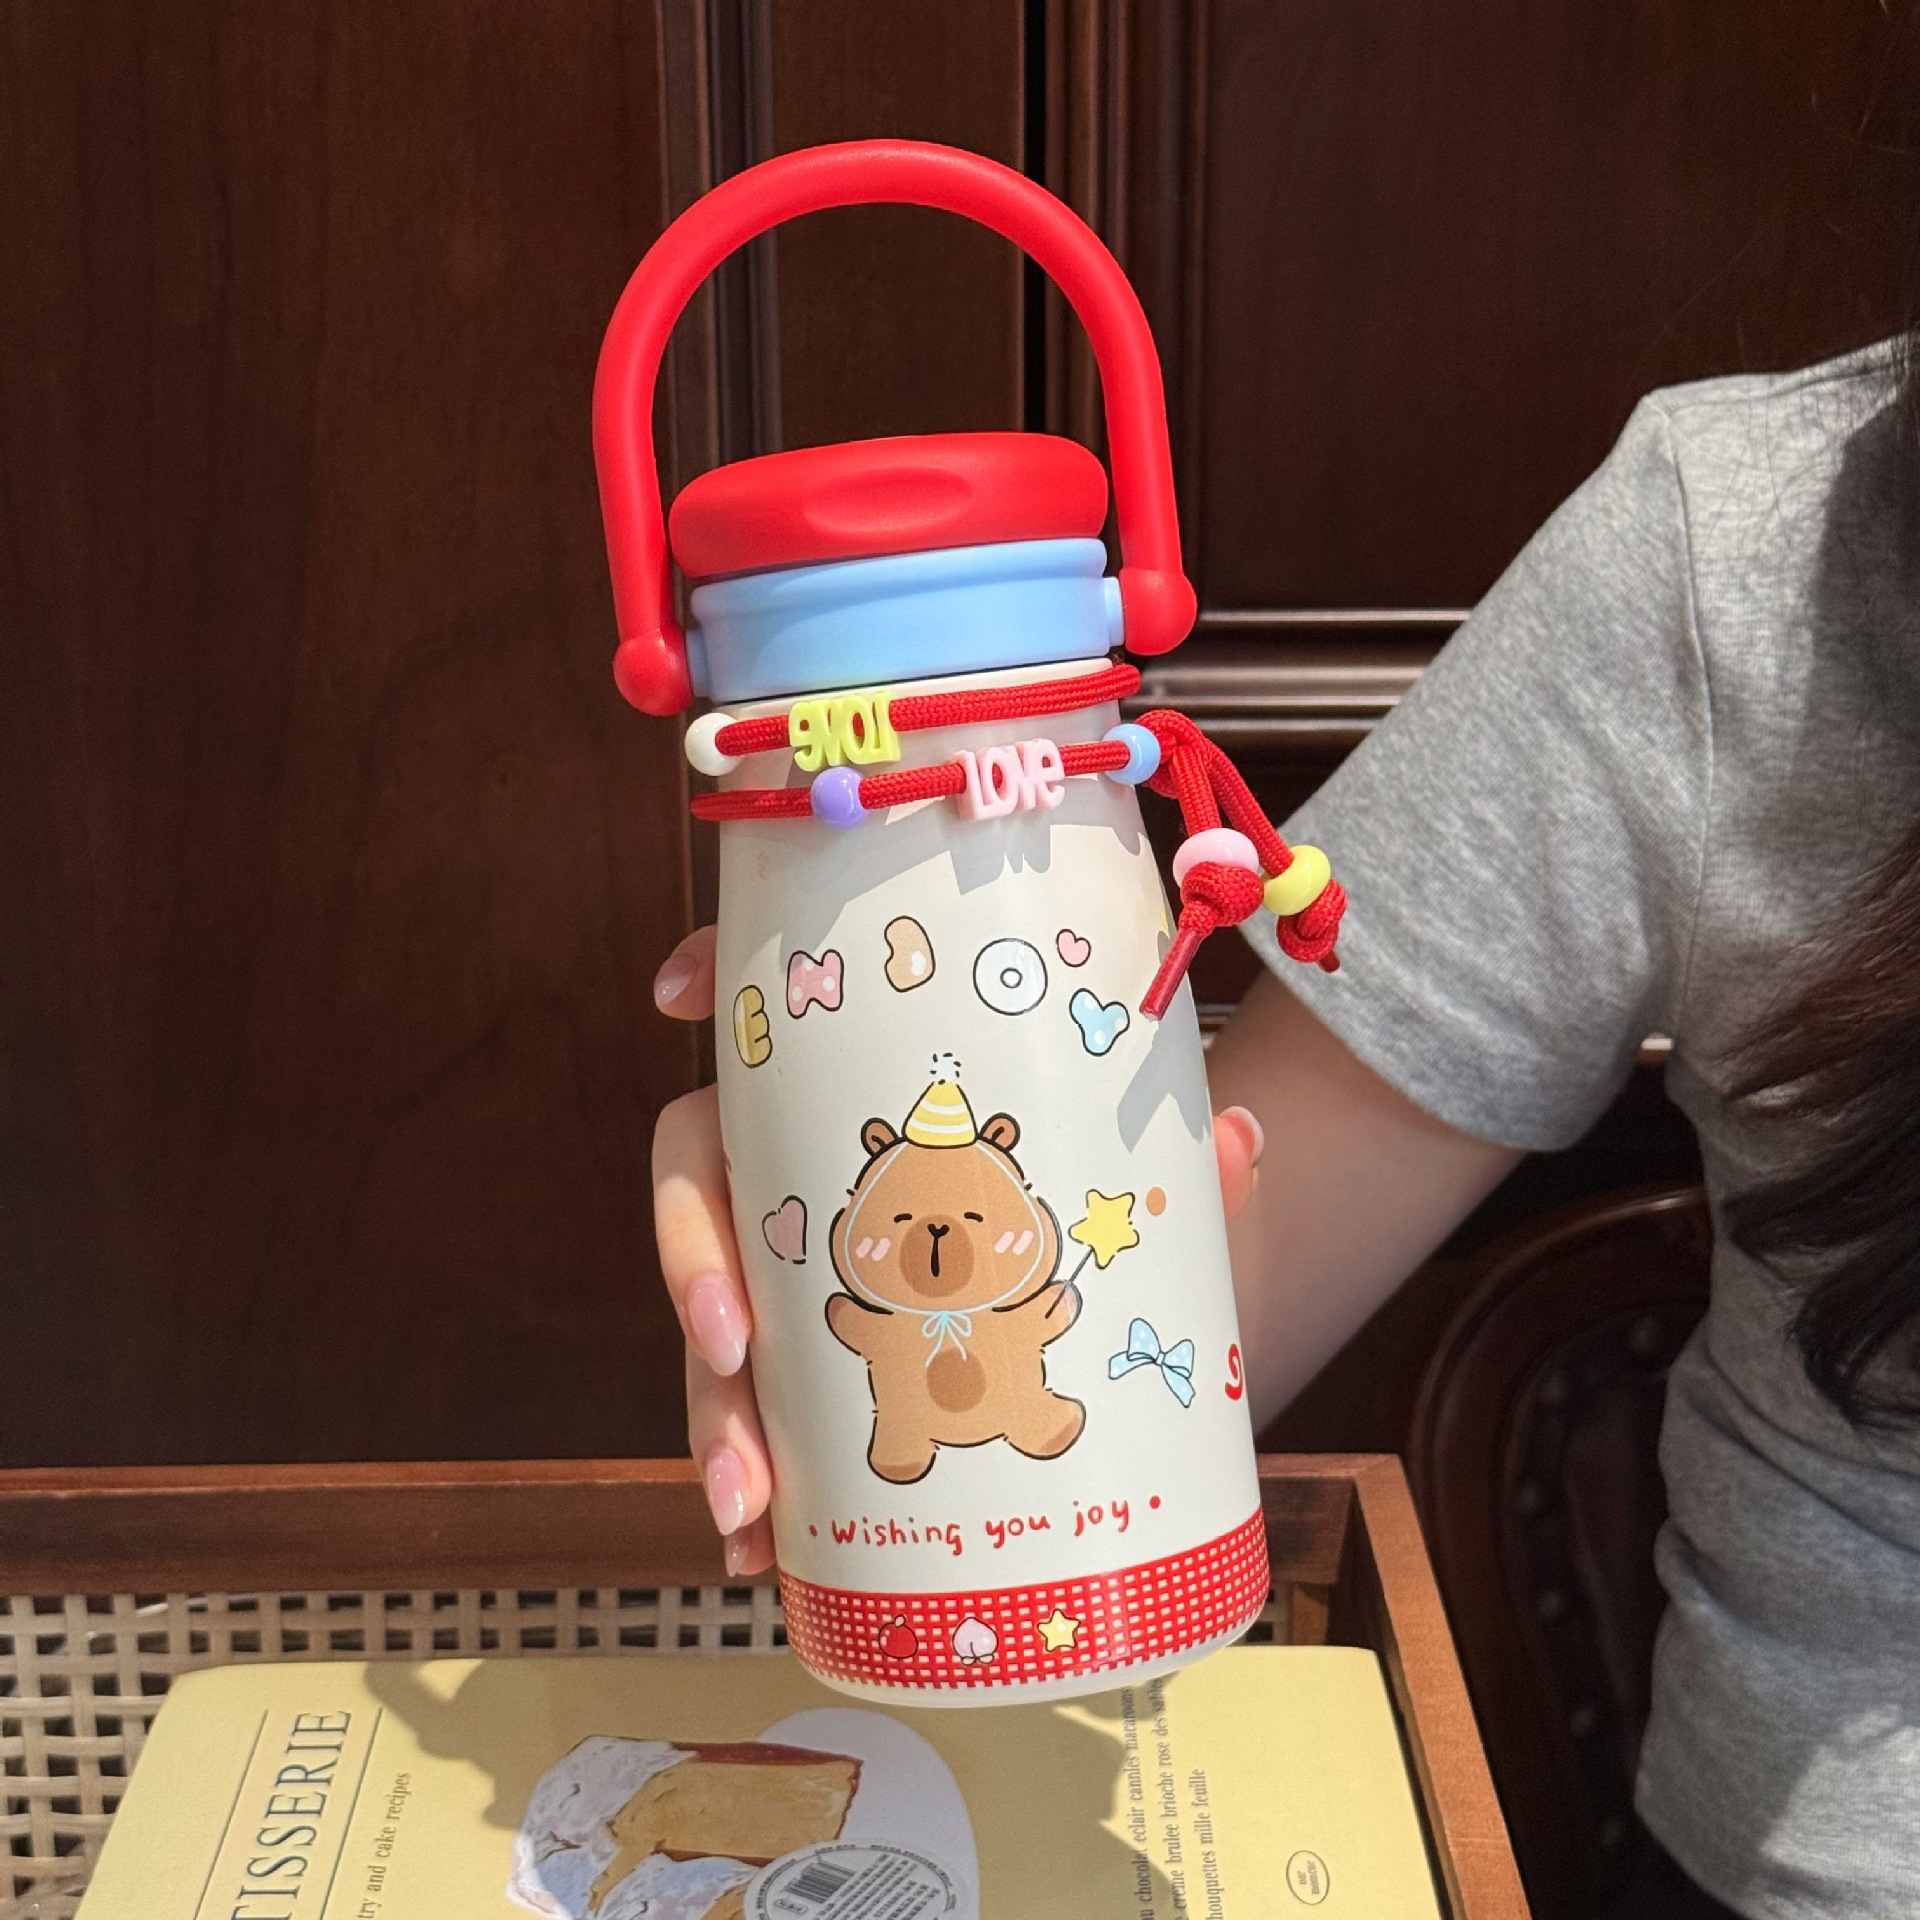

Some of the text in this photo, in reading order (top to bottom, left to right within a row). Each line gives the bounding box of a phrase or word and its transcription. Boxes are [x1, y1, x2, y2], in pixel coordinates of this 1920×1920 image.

[831, 1499, 1130, 1556] Wishing you joy
[1151, 1717, 1169, 1737] des
[1156, 1742, 1173, 1767] rose
[385, 1771, 413, 1823] recipes
[1155, 1771, 1179, 1818] brioche
[1188, 1768, 1208, 1807] feuille
[374, 1826, 398, 1859] cake
[1126, 1806, 1148, 1843] eclair
[1161, 1823, 1183, 1864] brulee
[1193, 1812, 1214, 1845] mille
[366, 1864, 387, 1893] and
[1170, 1870, 1188, 1910] creme
